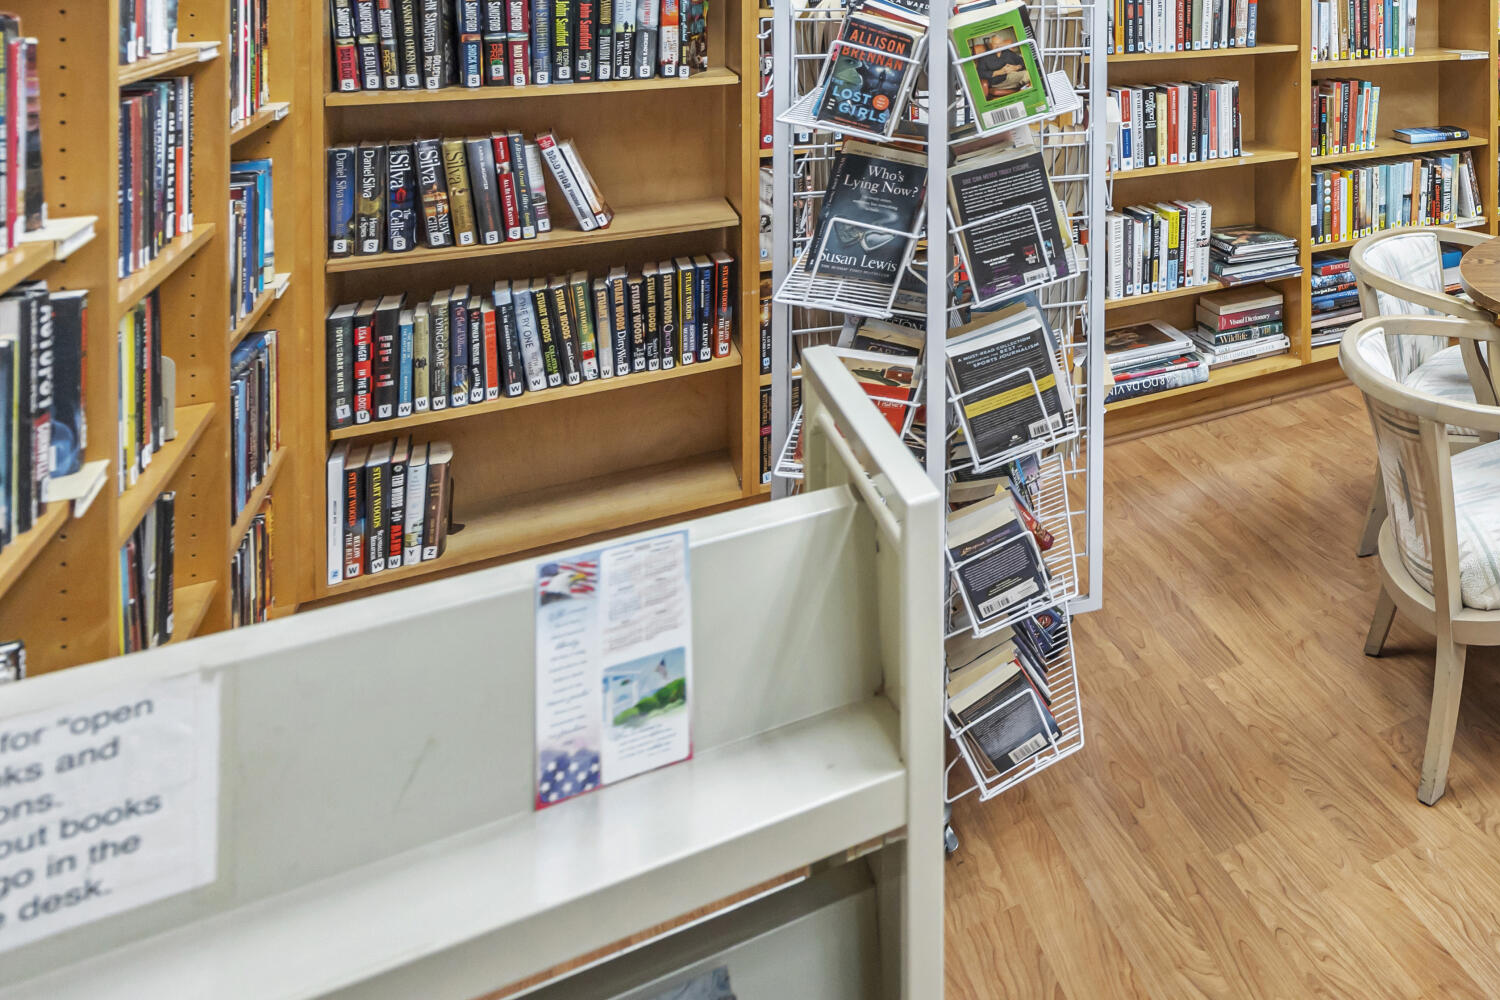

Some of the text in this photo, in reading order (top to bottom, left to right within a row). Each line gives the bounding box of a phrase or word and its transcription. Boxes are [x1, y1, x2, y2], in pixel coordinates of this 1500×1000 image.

[424, 13, 437, 52] SANDFORD
[556, 1, 570, 47] John Sandford
[580, 3, 592, 50] John Sandford
[850, 29, 906, 55] ALLISON
[842, 46, 904, 71] BRENNAN
[832, 86, 872, 104] LOST
[838, 102, 888, 123] GIRLS
[362, 151, 375, 198] Daniel Silva
[390, 152, 411, 189] Silva
[420, 149, 439, 185] Silva
[869, 165, 904, 182] Who's
[844, 174, 919, 197] Lying Now?
[821, 251, 898, 272] Susan Lewis
[632, 285, 642, 344] STUART WOODS
[648, 306, 656, 332] WOODS
[1229, 313, 1271, 326] Visual Dictionary
[996, 336, 1031, 350] COLLECTION
[1000, 345, 1015, 354] BEST
[1219, 333, 1248, 344] Wildlife
[973, 343, 1040, 368] SPORTS JOURNALISM
[348, 472, 356, 498] STUART
[373, 467, 382, 528] STUART WOODS
[55, 736, 121, 773] and
[59, 794, 162, 839] books
[46, 854, 77, 878] in
[89, 834, 142, 864] the
